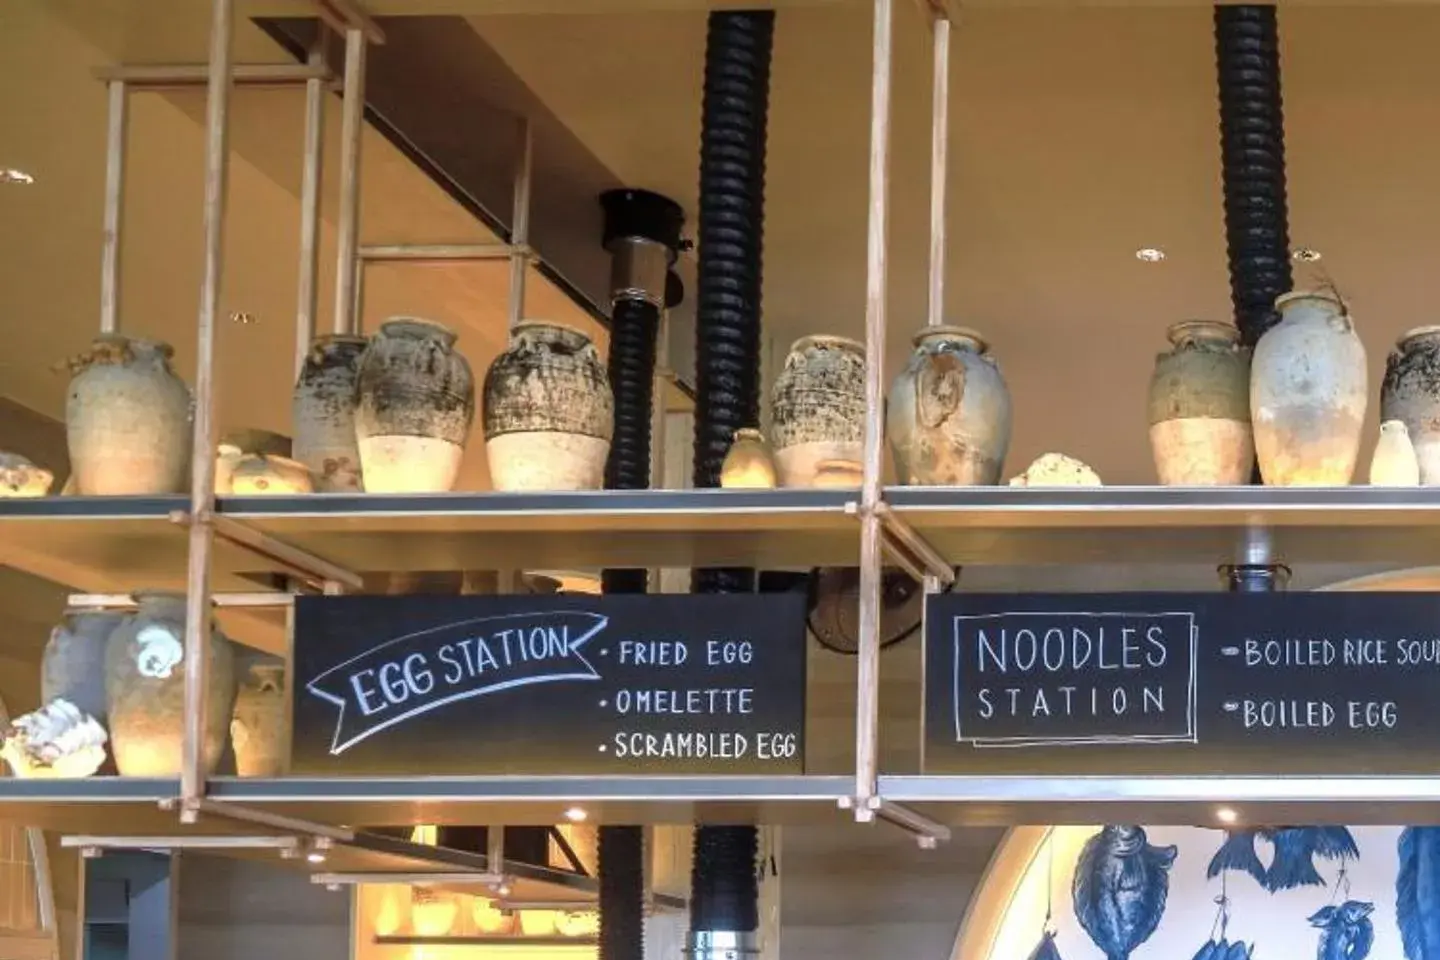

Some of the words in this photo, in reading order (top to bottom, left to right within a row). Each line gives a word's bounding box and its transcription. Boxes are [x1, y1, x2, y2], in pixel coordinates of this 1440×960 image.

[619, 640, 688, 666] FRIED
[706, 640, 753, 666] EGG
[978, 626, 1167, 673] NOODLES
[1245, 638, 1336, 667] BOILED
[1343, 638, 1388, 665] RICE
[350, 652, 436, 717] EGG
[438, 625, 571, 685] STATION
[615, 689, 754, 714] OMELETTE
[979, 686, 1165, 719] STATION
[1244, 699, 1336, 729] BOILED
[1348, 699, 1398, 729] EGG
[615, 733, 748, 759] SCRAMBLED
[756, 733, 797, 759] EGG
